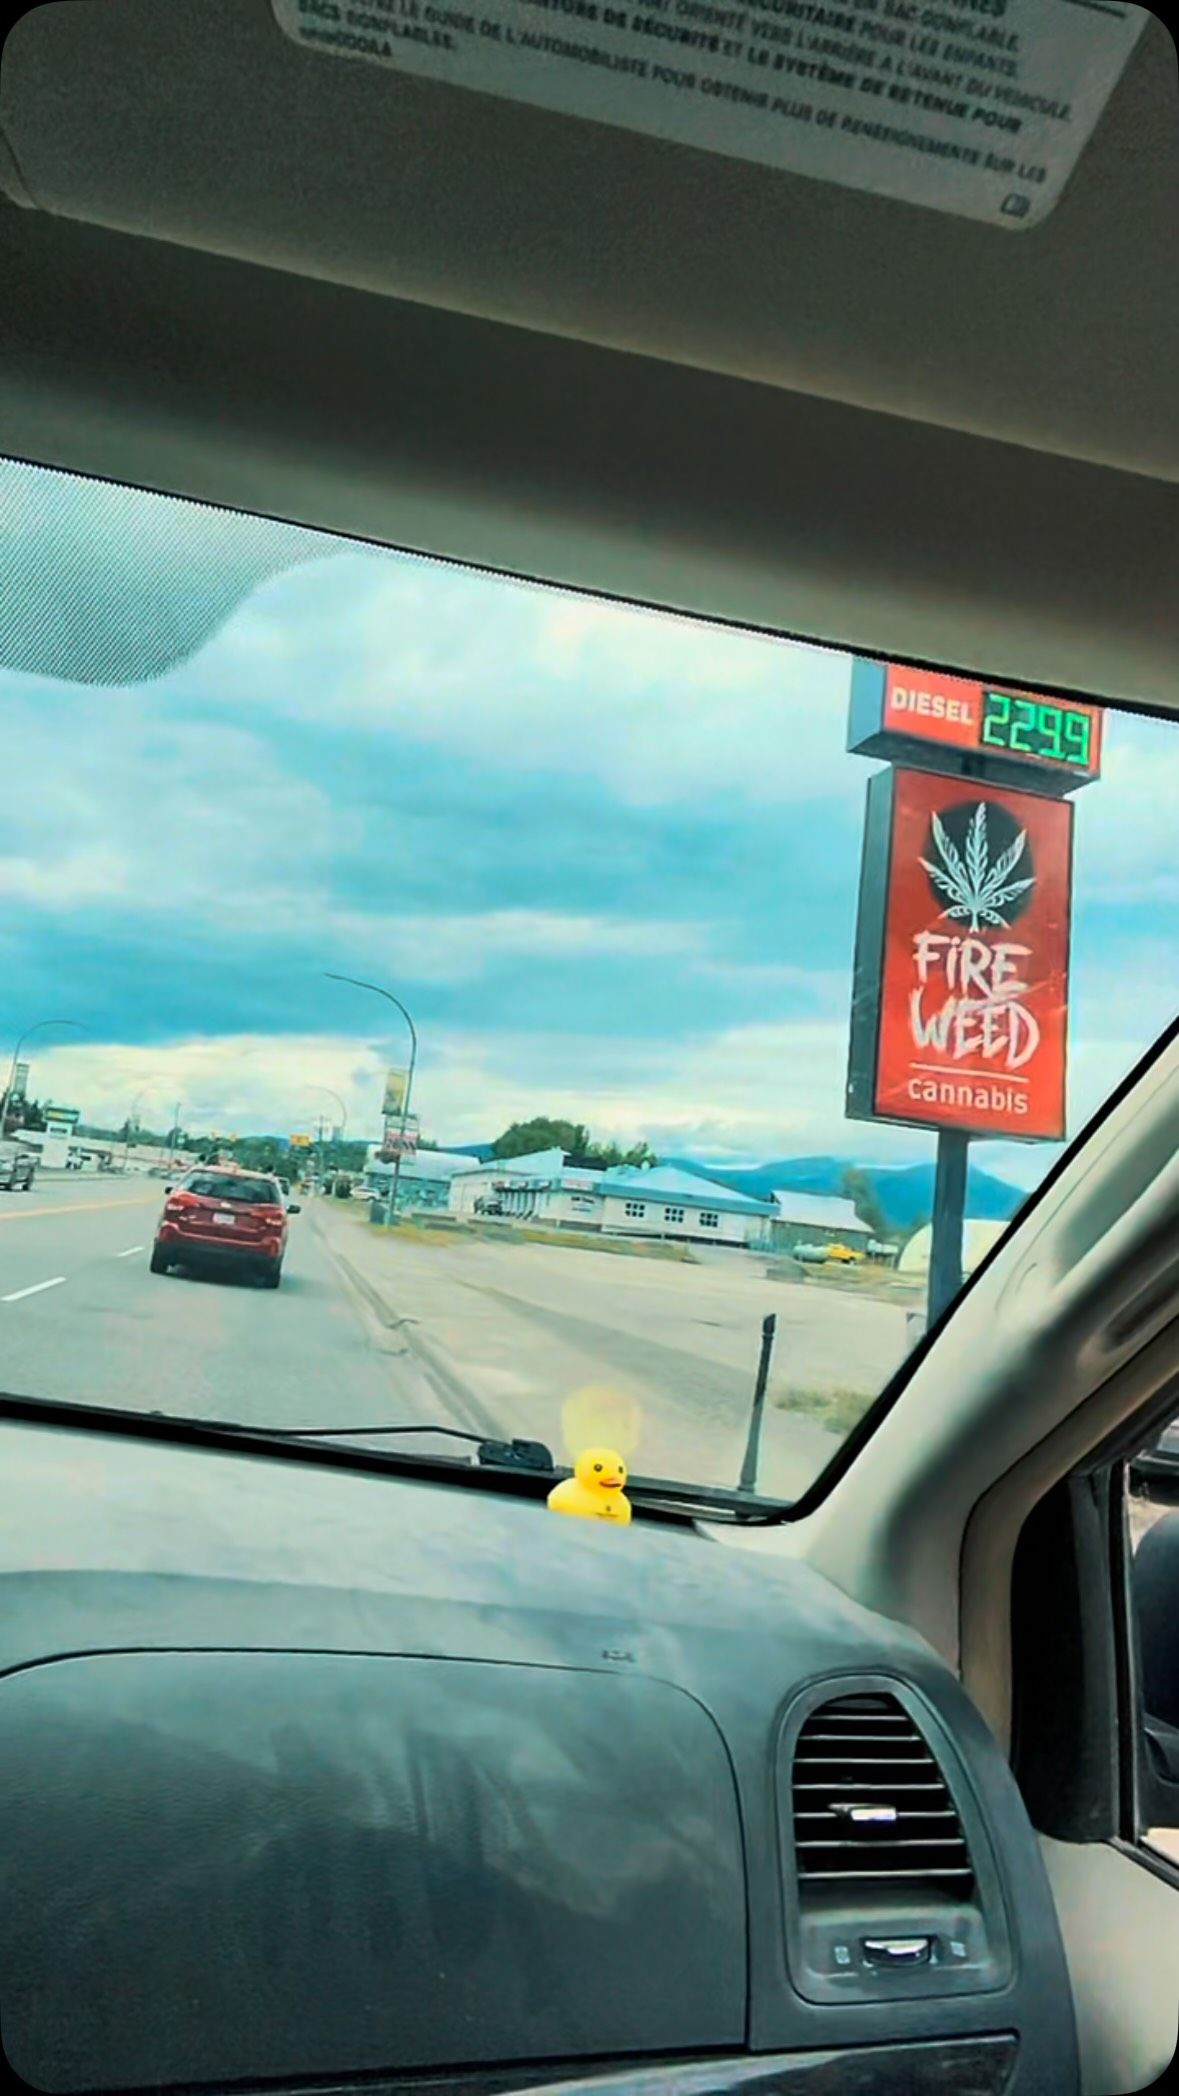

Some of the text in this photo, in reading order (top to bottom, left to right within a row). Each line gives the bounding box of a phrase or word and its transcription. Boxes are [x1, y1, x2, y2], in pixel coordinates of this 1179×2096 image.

[424, 6, 474, 34] GUIDE
[480, 20, 501, 41] DE
[506, 26, 648, 78] L'AUTOMOBILISTE
[652, 65, 696, 89] POUR
[700, 78, 769, 109] OBTENIR
[771, 98, 813, 122] PLUS
[816, 110, 838, 129] DE
[984, 153, 1016, 172] SUR
[1018, 164, 1047, 184] LES
[603, 8, 627, 29] DE
[747, 47, 770, 67] LE
[859, 77, 888, 96] DE
[888, 84, 969, 118] RETENUE
[971, 107, 1023, 134] POUR
[891, 686, 974, 725] DIESEL
[908, 985, 1041, 1072] WEED
[908, 1078, 1029, 1117] cannabis
